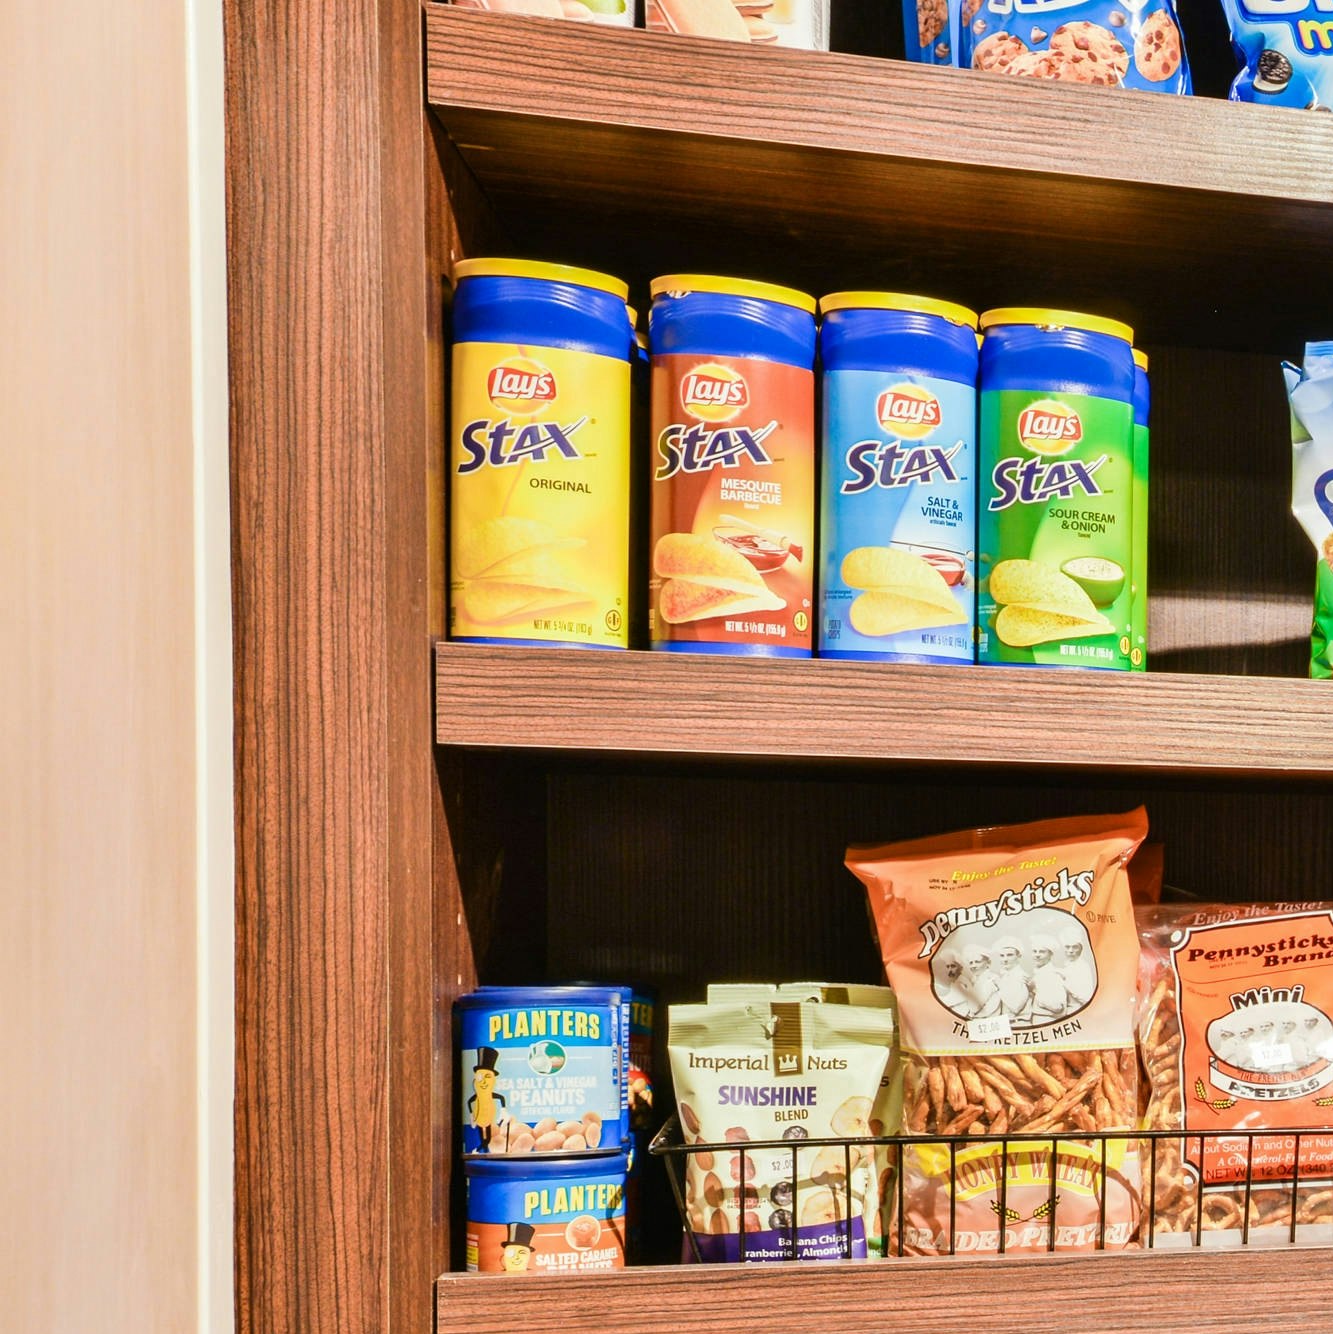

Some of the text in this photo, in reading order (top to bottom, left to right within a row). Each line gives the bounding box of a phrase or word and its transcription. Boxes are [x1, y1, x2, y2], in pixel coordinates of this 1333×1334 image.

[530, 478, 591, 494] ORIGINAL
[721, 478, 781, 494] MESQUITE
[720, 490, 781, 505] BARBECUE
[922, 507, 963, 521] VINEGAR
[1049, 509, 1115, 524] SOUR CREAM
[951, 856, 1057, 882] Enjoy the Taste!
[1192, 901, 1323, 926] Enjoy the Taste!
[1230, 985, 1305, 1011] Mini
[489, 1010, 600, 1042] PLANTERS
[1053, 1020, 1082, 1036] MEN
[689, 1053, 847, 1071] Imperial Nuts
[509, 1089, 586, 1107] PEANUTS
[718, 1085, 816, 1107] SUNSHINE
[775, 1108, 808, 1122] BLEND
[1264, 1140, 1282, 1150] and
[1310, 1152, 1333, 1162] Food
[525, 1183, 623, 1218] PLANTERS
[536, 1249, 618, 1268] SALTED CARAMEL
